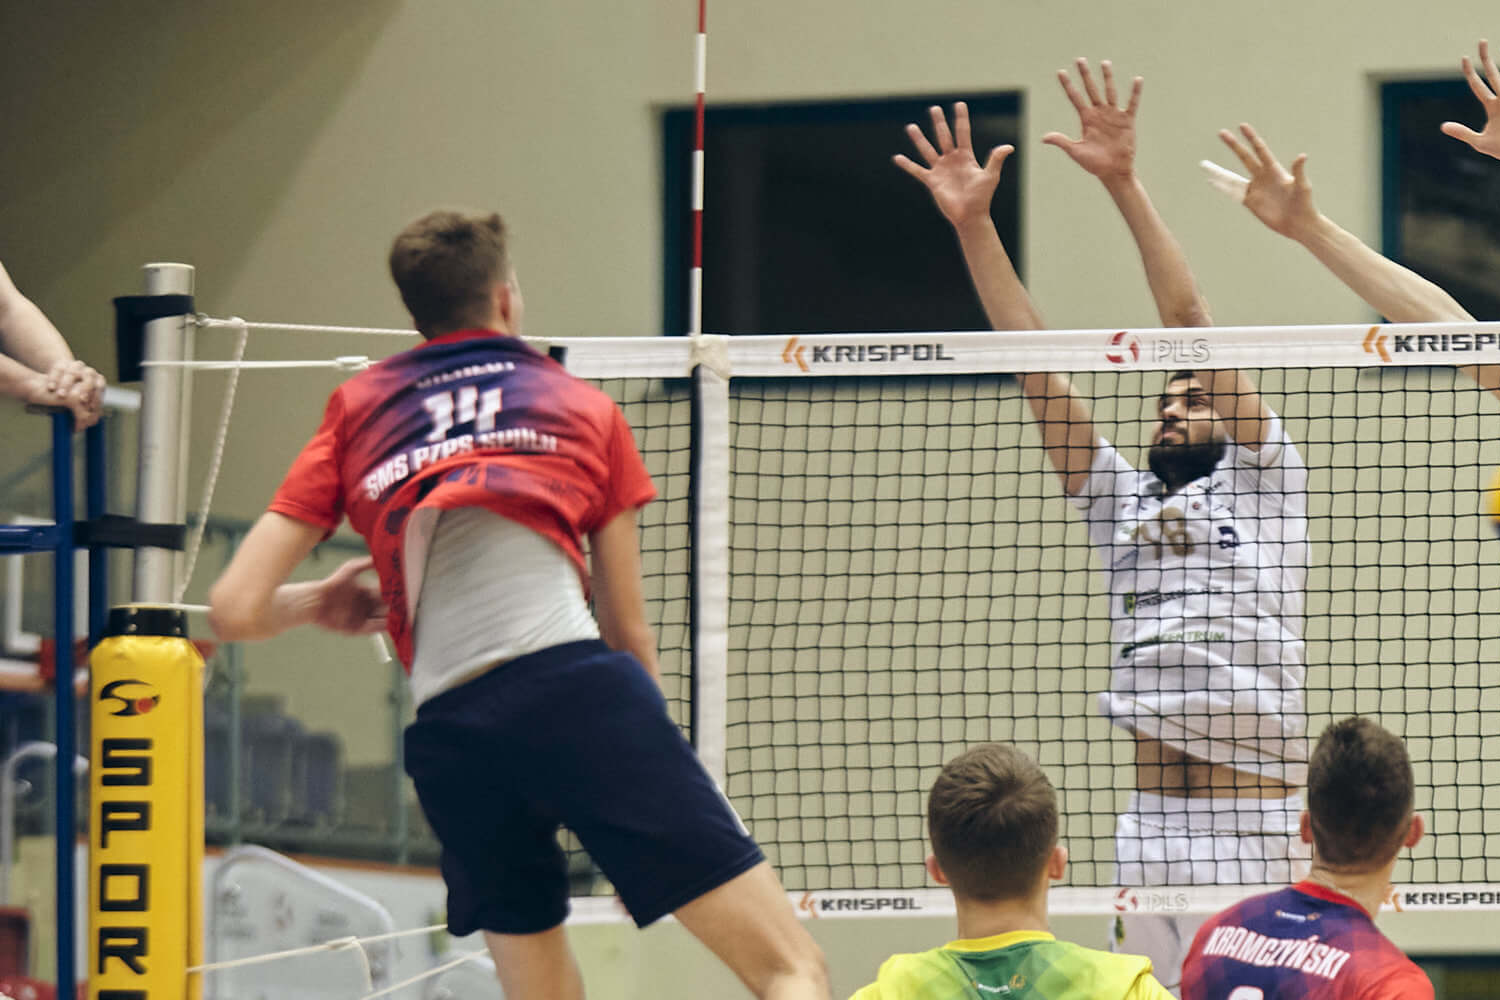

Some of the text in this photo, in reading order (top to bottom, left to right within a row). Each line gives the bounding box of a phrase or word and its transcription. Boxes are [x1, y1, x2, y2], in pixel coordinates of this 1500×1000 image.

[812, 342, 955, 364] KRISPOL
[1151, 337, 1211, 364] PLS
[364, 453, 410, 501] SMS
[820, 896, 923, 913] KRISPOL
[1145, 892, 1190, 913] PLS
[1203, 925, 1351, 980] KRAMCZYŃSKI
